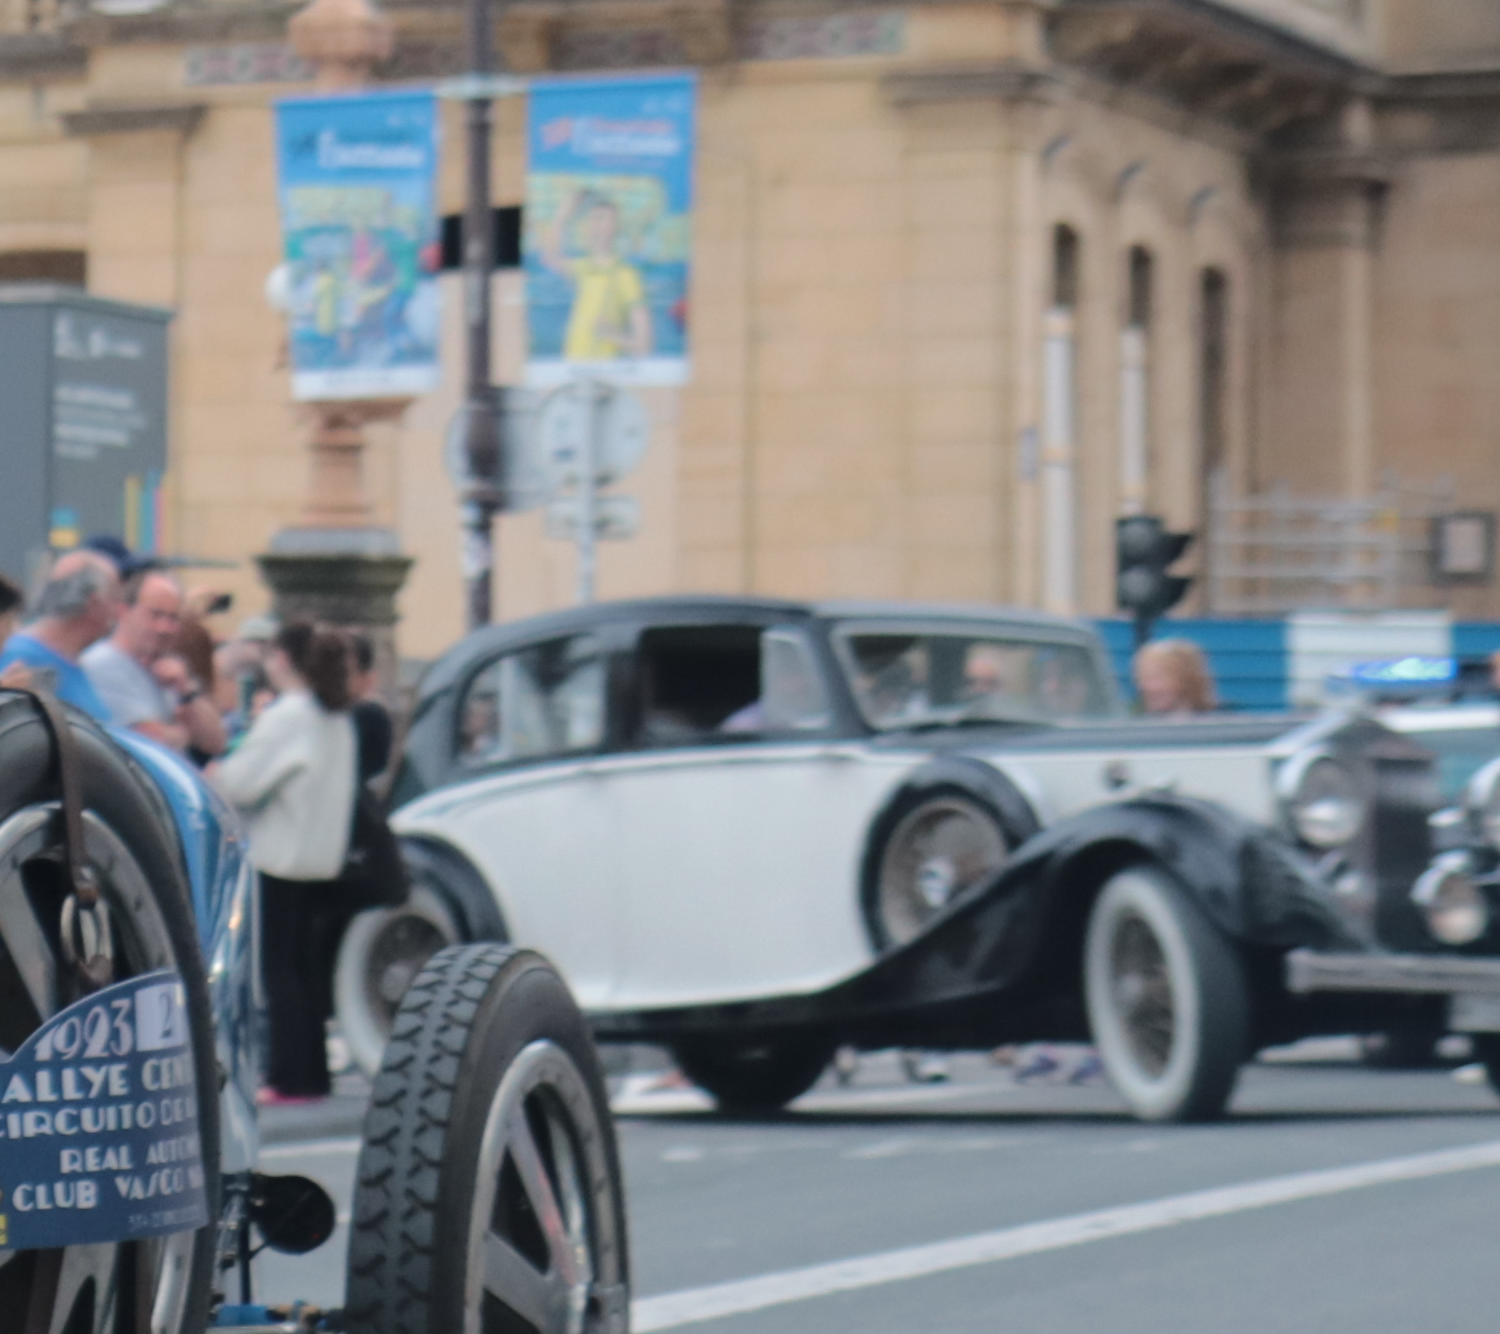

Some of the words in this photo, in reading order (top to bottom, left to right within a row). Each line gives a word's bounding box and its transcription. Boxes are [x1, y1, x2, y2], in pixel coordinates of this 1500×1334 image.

[34, 997, 134, 1062] 1923
[60, 1144, 133, 1174] REAL
[11, 1178, 99, 1212] CLUB
[114, 1167, 184, 1201] VASCO
